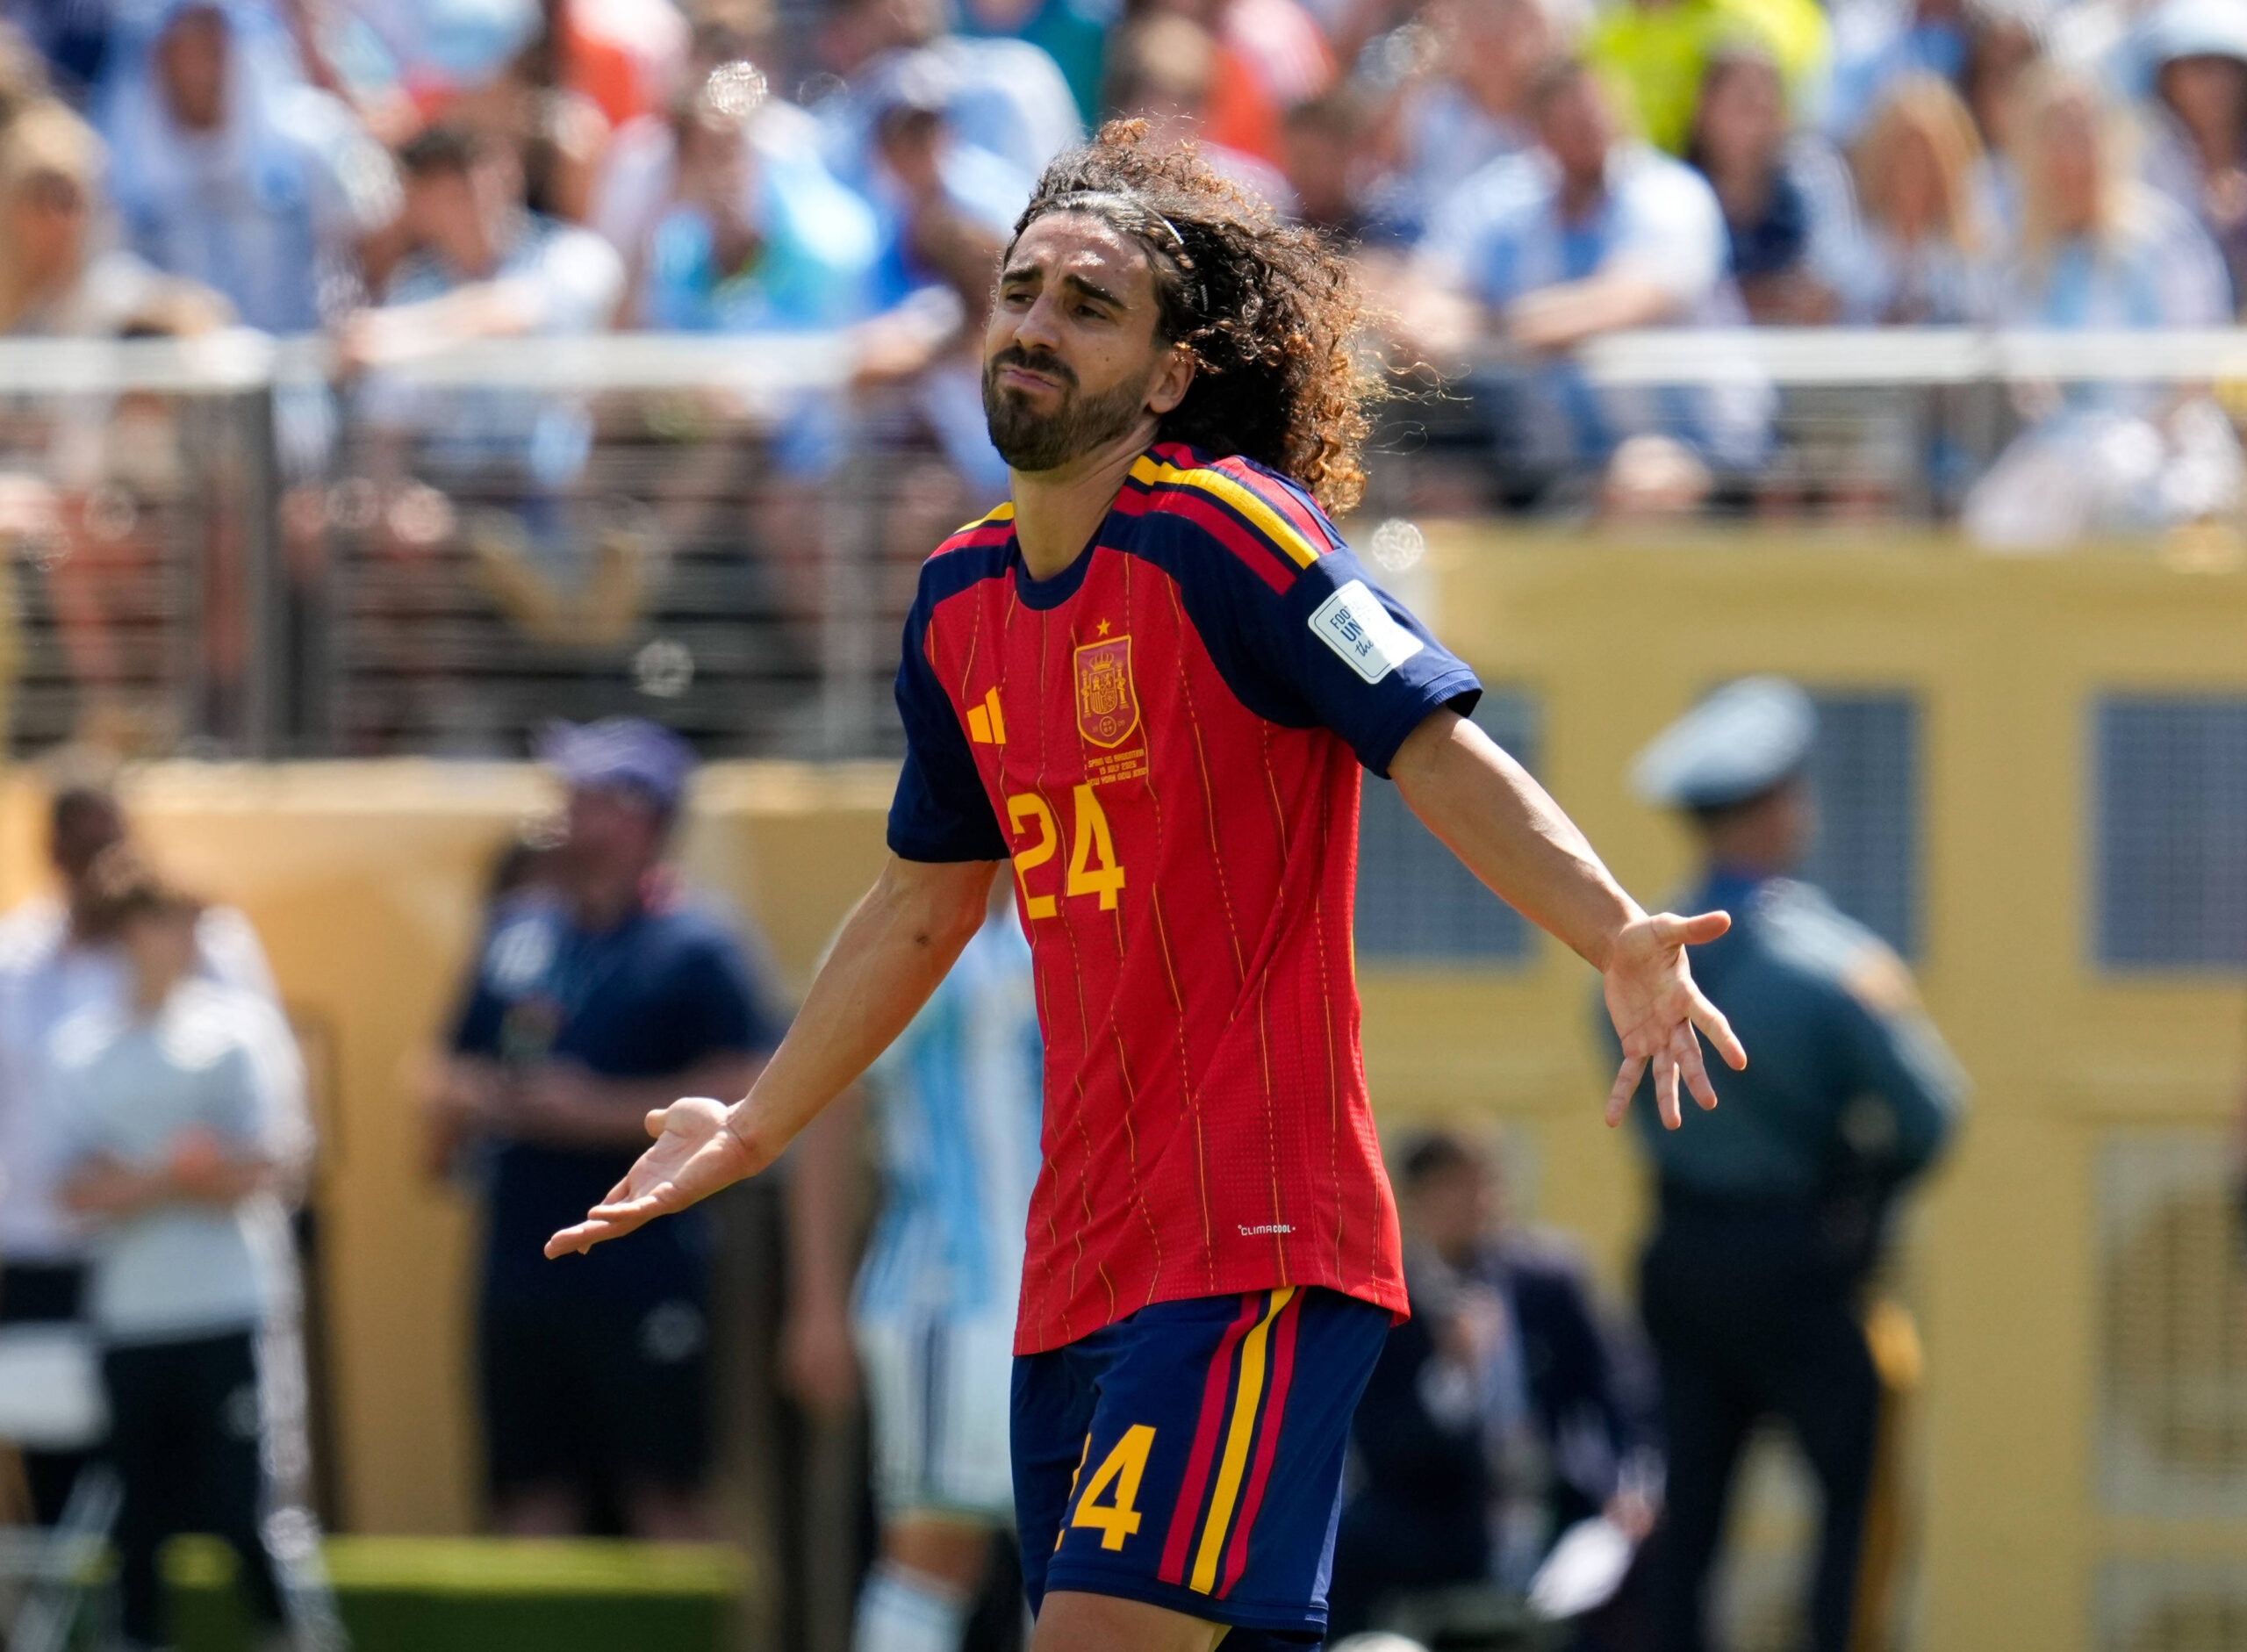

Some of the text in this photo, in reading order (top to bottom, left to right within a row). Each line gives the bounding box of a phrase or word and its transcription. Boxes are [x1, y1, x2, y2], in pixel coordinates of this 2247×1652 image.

[1008, 783, 1126, 920] 24
[1240, 1225, 1291, 1236] CLIMACOOL
[1054, 1423, 1157, 1552] 4
